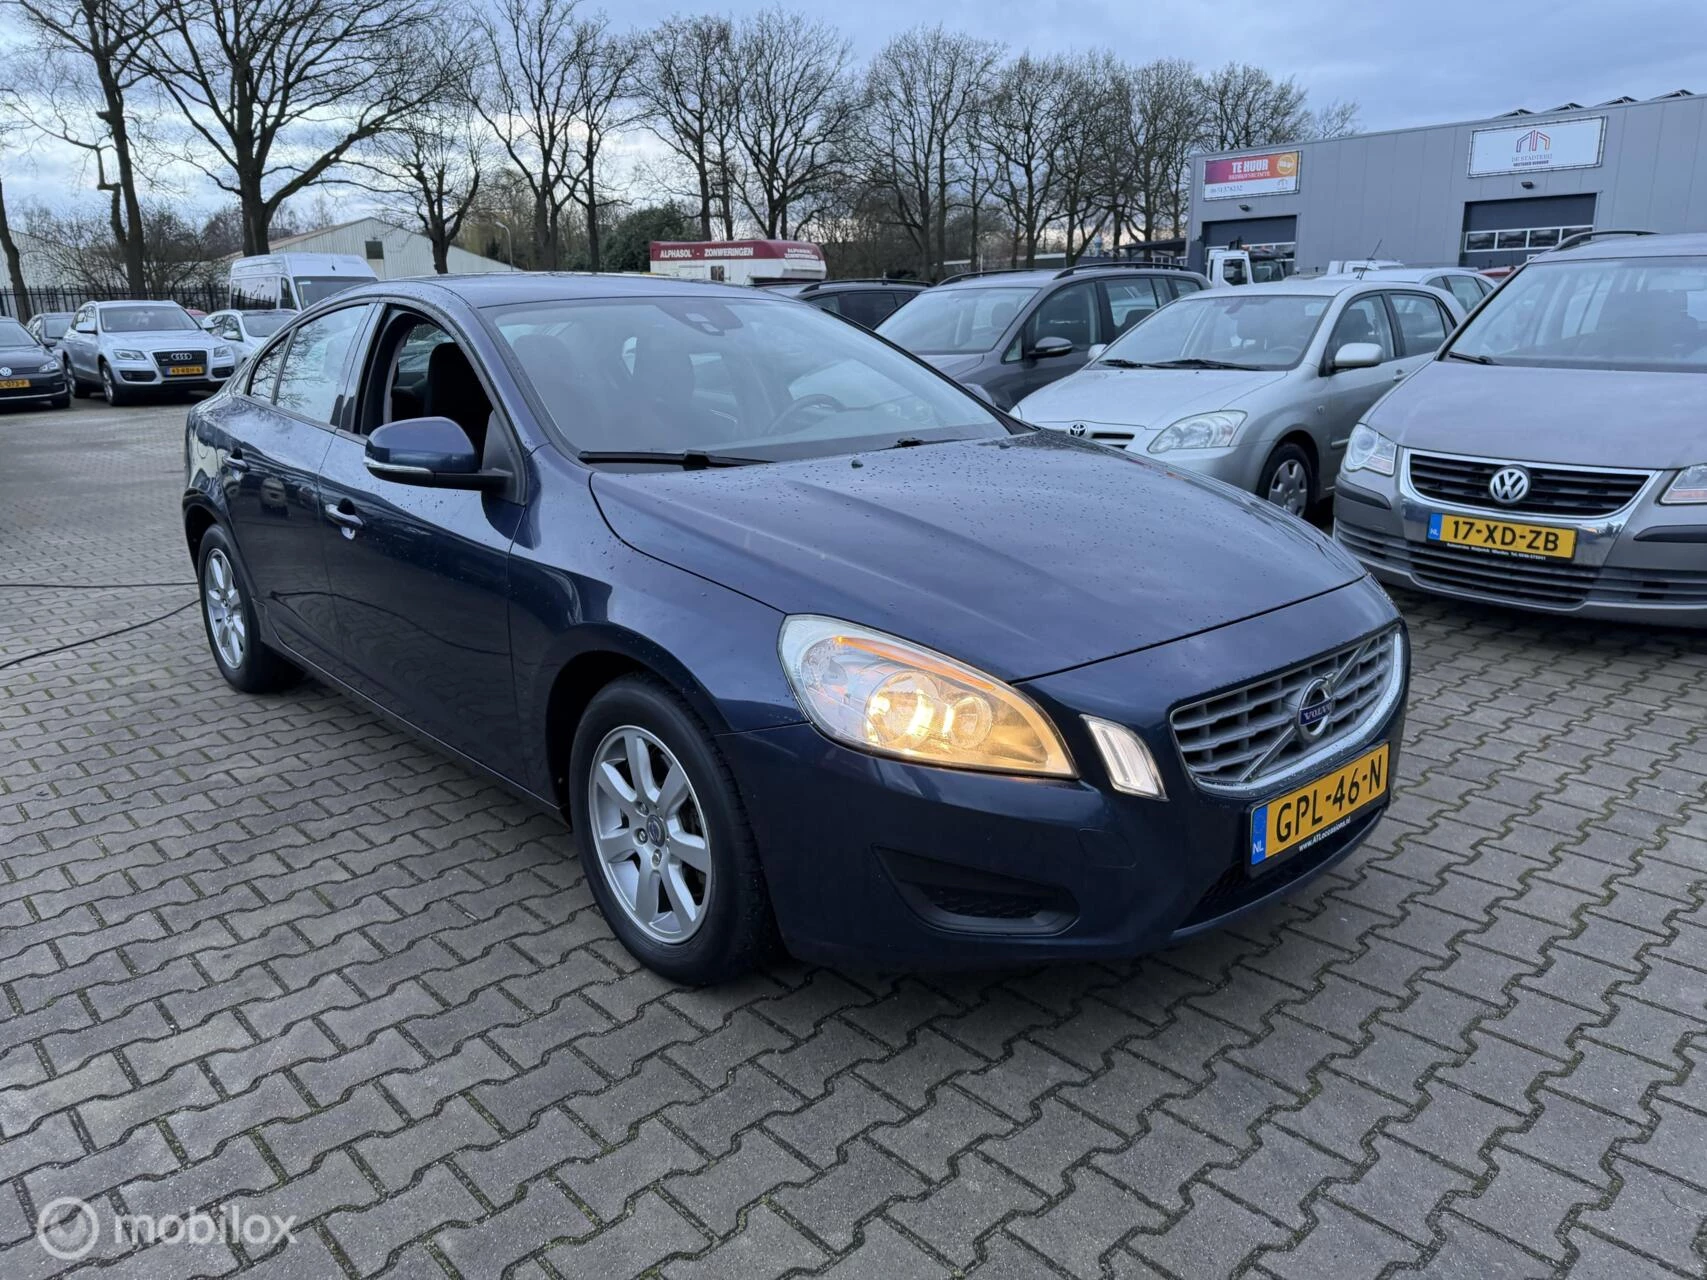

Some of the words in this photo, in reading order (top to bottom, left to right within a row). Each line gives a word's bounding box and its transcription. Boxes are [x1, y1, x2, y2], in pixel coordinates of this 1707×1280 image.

[1232, 162, 1242, 173] TE
[1244, 159, 1268, 172] HUUR
[660, 248, 692, 258] ALPHASOL
[704, 247, 753, 257] ZONWERINGEN
[1429, 527, 1439, 536] NL
[1453, 520, 1560, 552] 17-XD-ZB
[1276, 754, 1382, 843] GPL-46-N
[1252, 840, 1264, 855] NL
